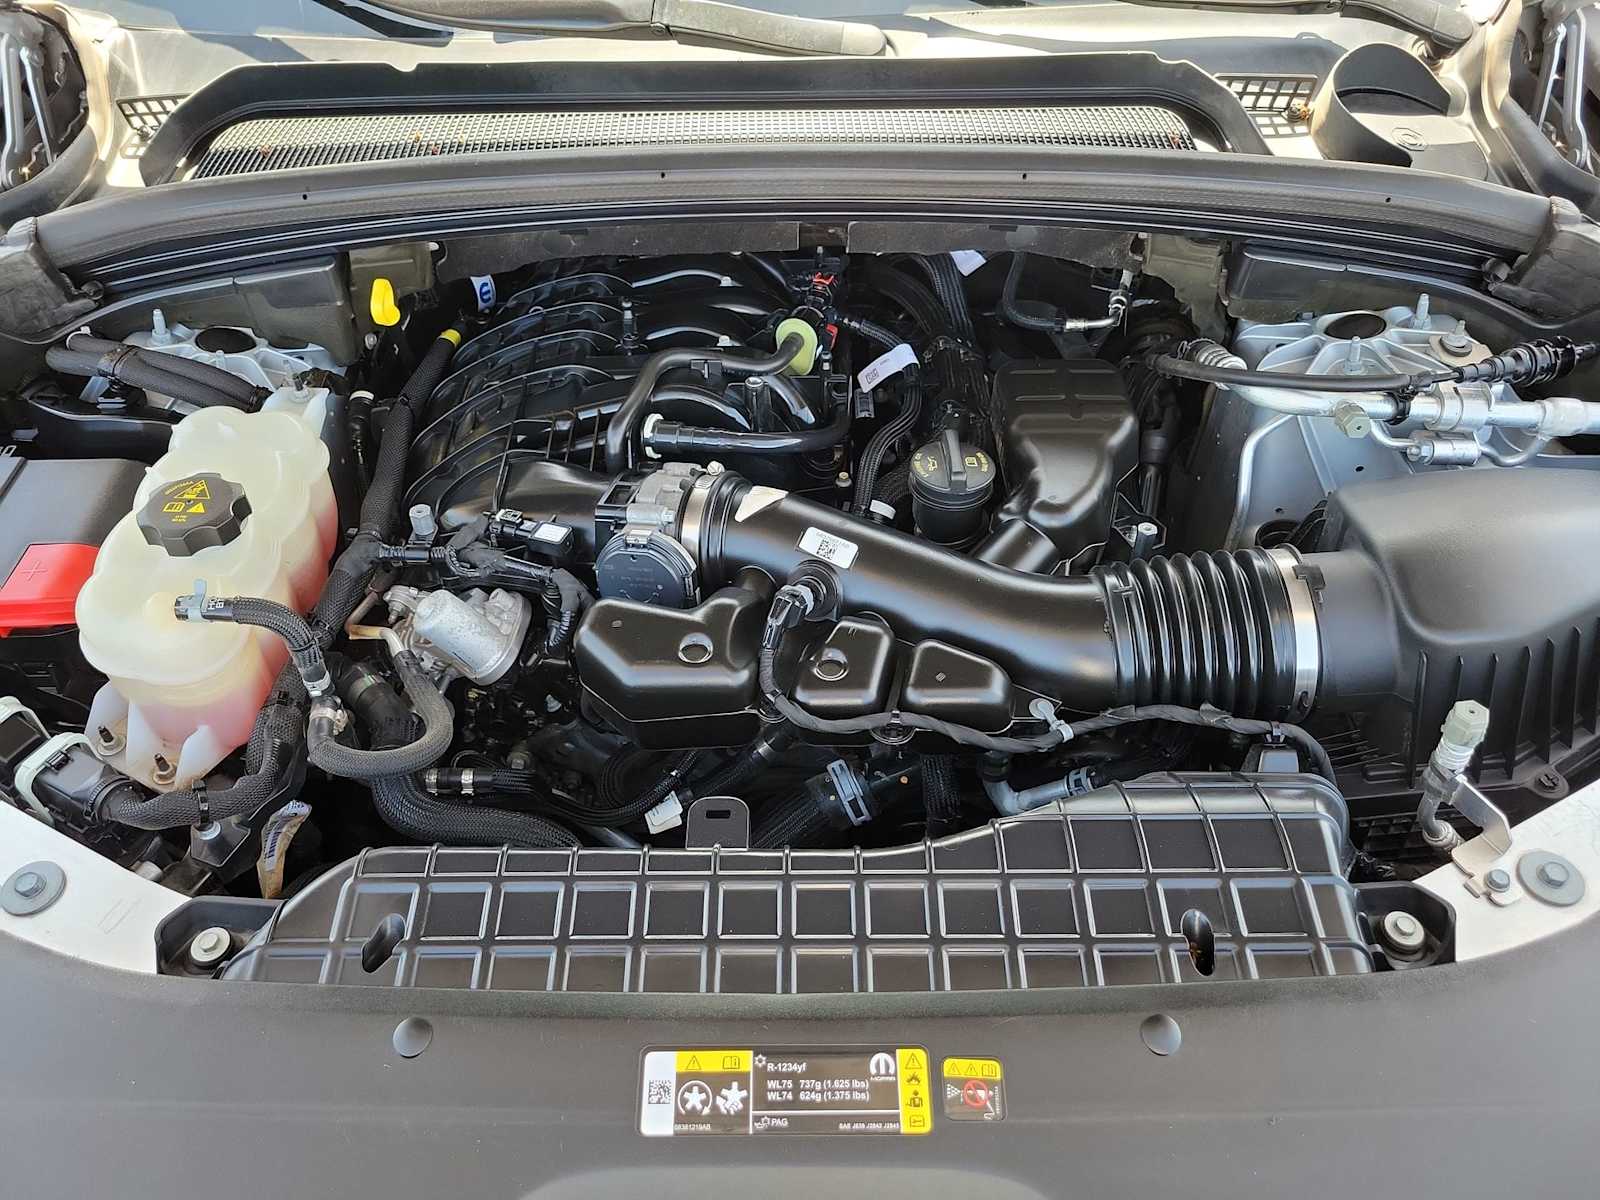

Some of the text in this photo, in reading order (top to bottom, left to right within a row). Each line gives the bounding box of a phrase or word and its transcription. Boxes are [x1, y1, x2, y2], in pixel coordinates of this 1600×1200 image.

[767, 1062, 807, 1074] R-1234yf
[767, 1079, 869, 1091] WL75 737g (1.625 lbs)
[767, 1091, 870, 1102] WL74 624g (1.375 lbs)
[771, 1117, 788, 1127] PAG
